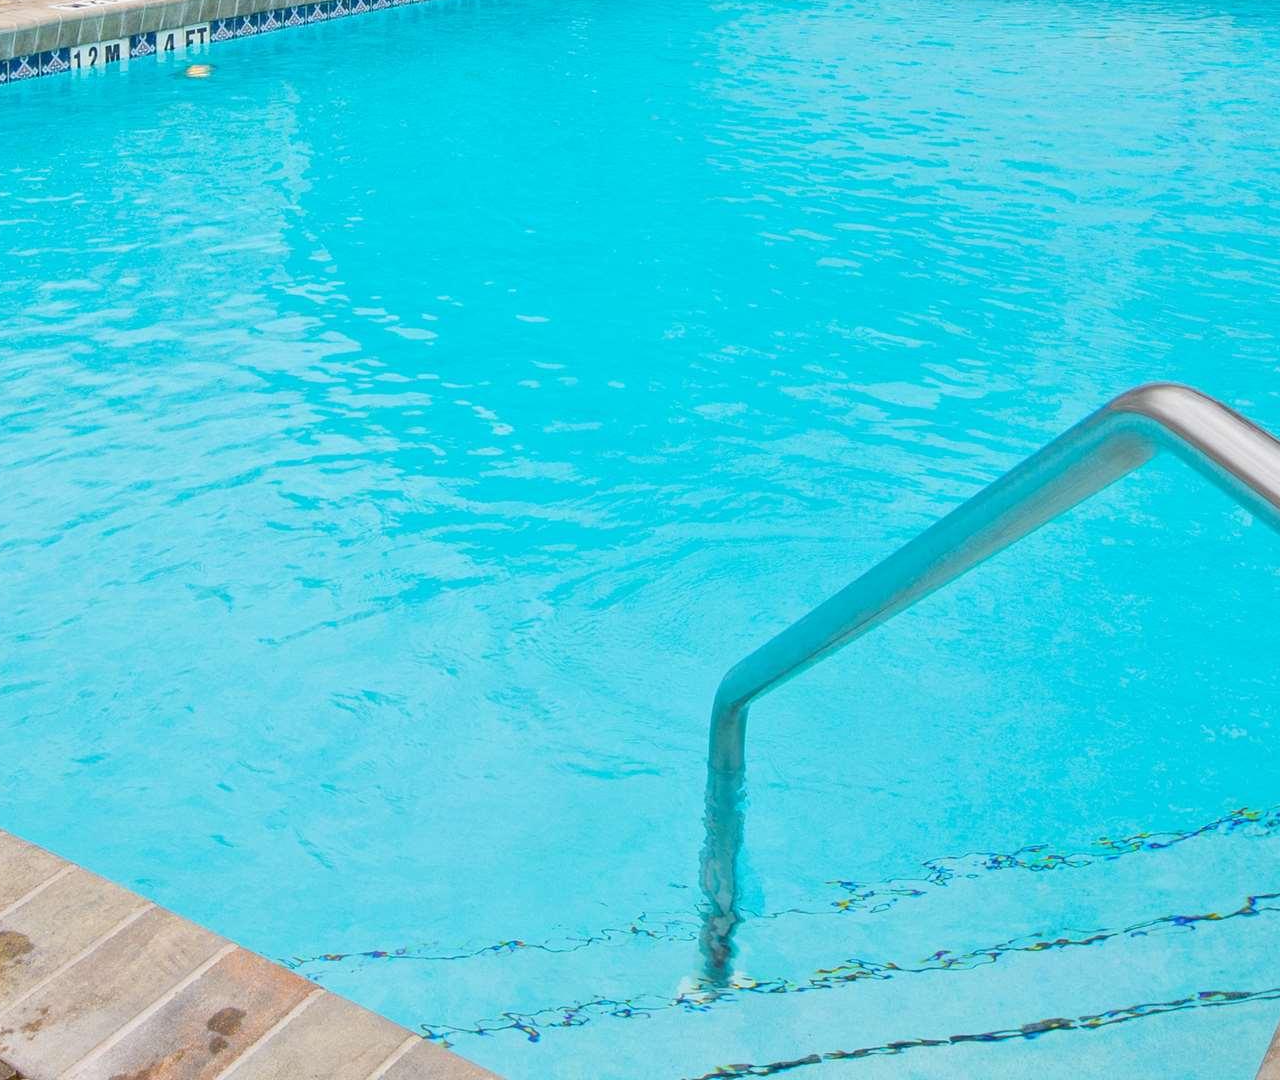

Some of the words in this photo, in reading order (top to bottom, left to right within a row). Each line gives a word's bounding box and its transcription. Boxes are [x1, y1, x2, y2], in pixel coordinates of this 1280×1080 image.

[105, 43, 121, 63] M
[165, 33, 175, 51] 4
[185, 27, 208, 47] FT
